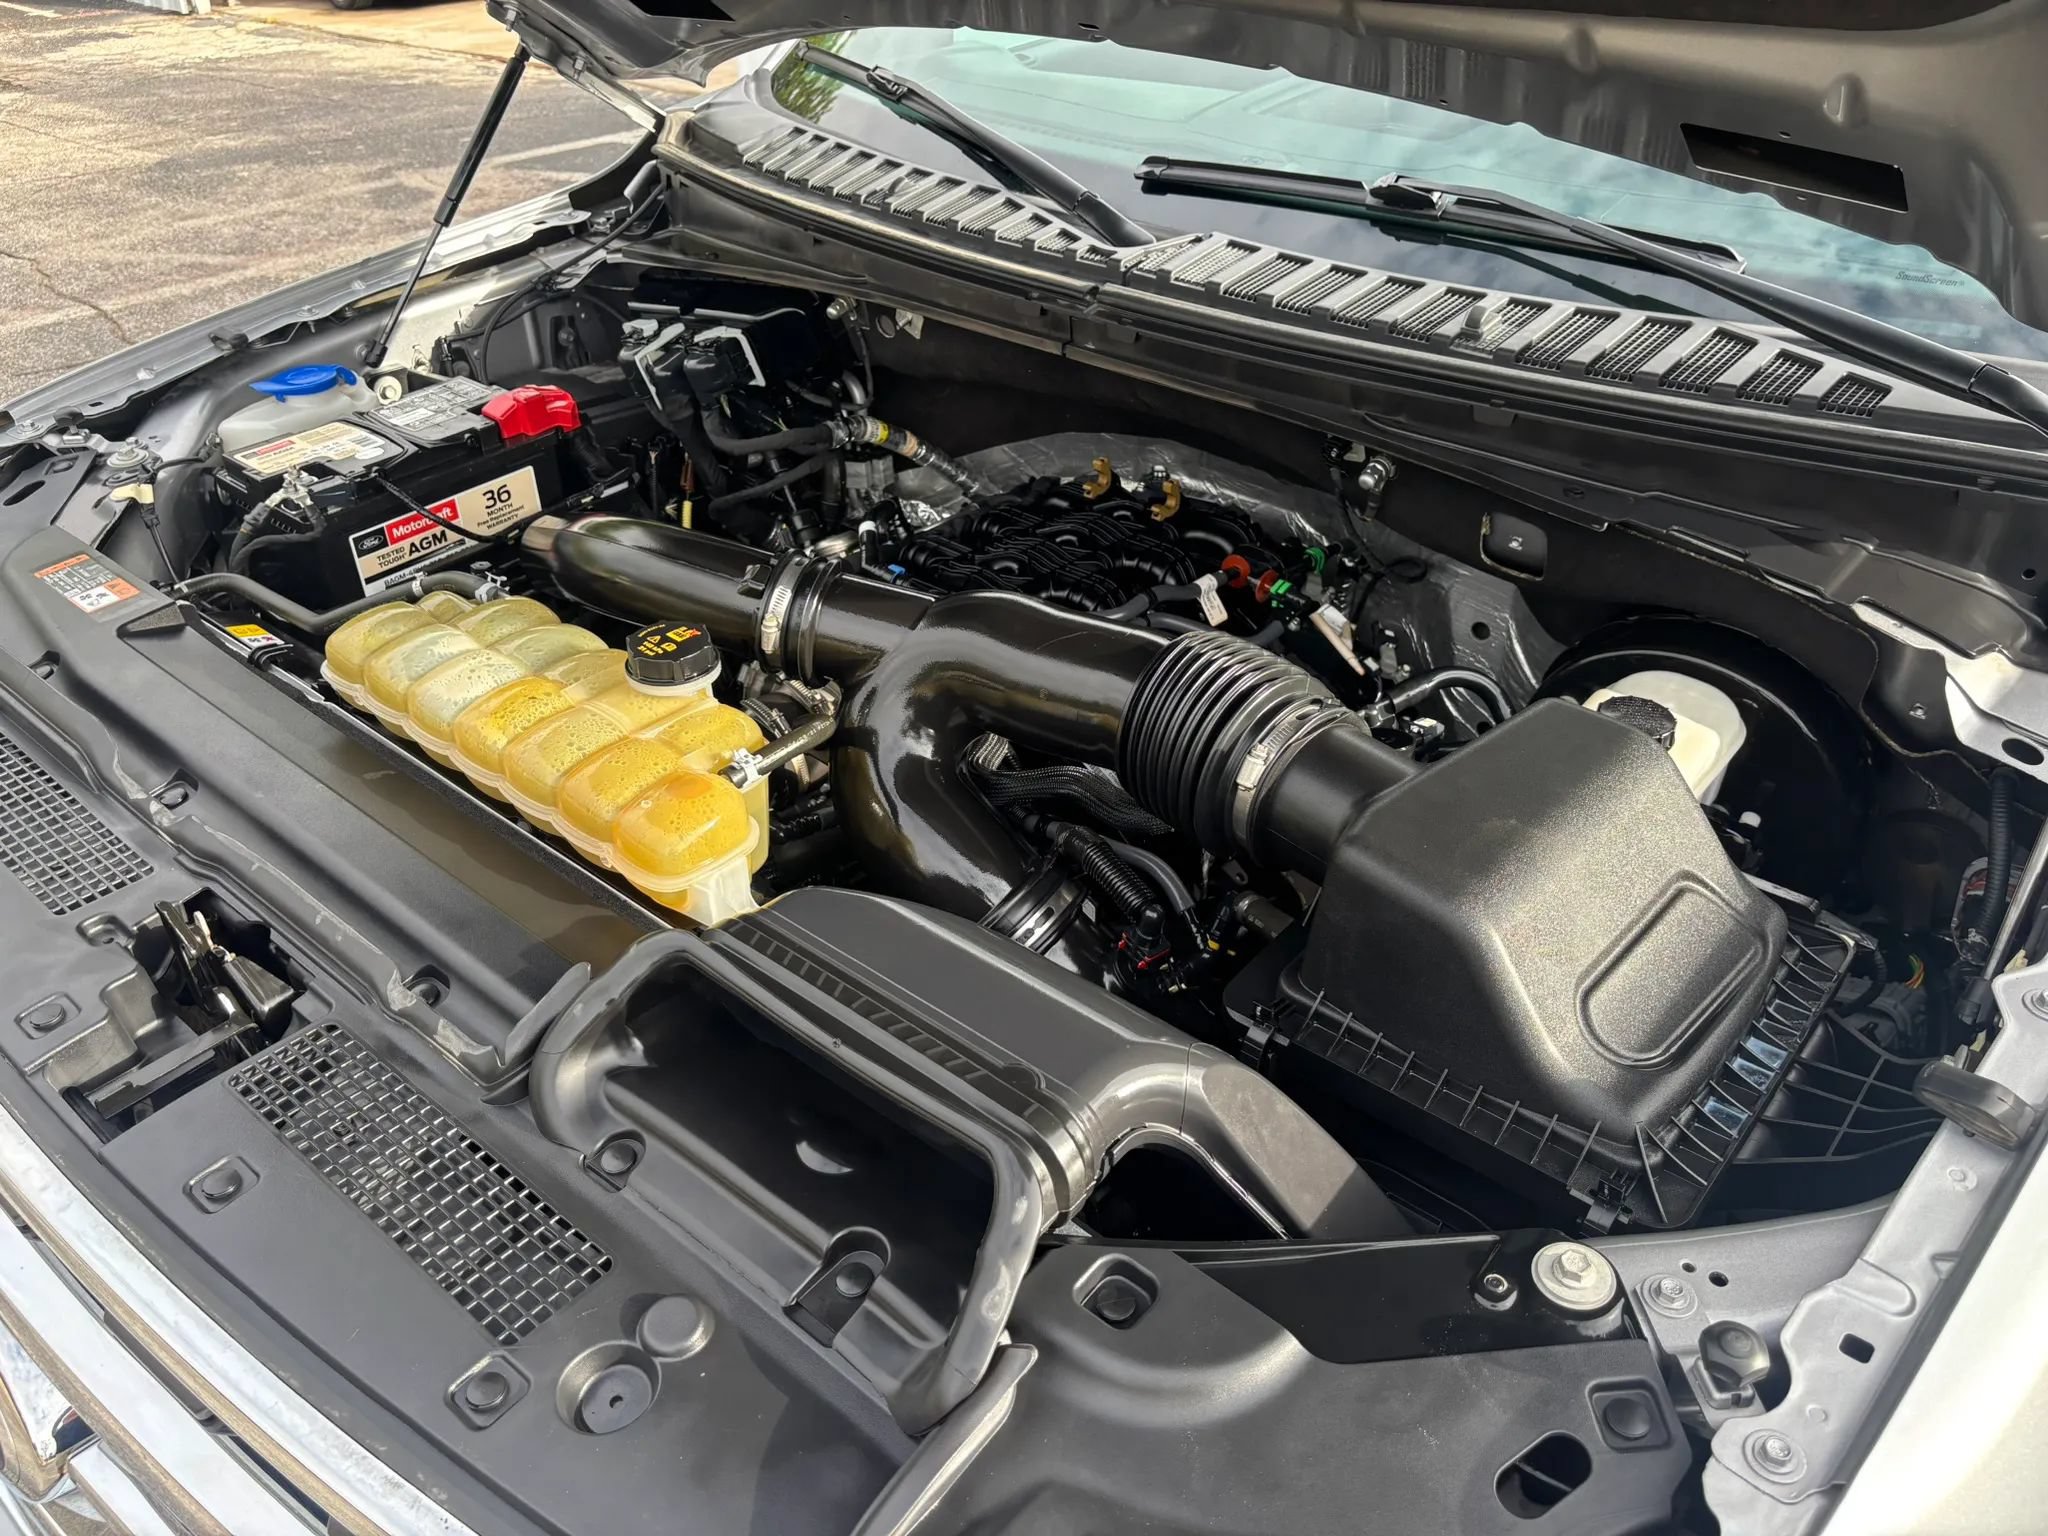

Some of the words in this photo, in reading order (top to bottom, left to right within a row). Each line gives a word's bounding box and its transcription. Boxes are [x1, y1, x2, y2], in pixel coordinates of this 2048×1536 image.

[1895, 271, 1958, 286] SoundScreen
[482, 484, 511, 509] 36
[487, 503, 513, 517] MONTH
[487, 513, 518, 529] WARRANTY
[409, 530, 448, 557] AGM
[377, 546, 405, 561] TESTED
